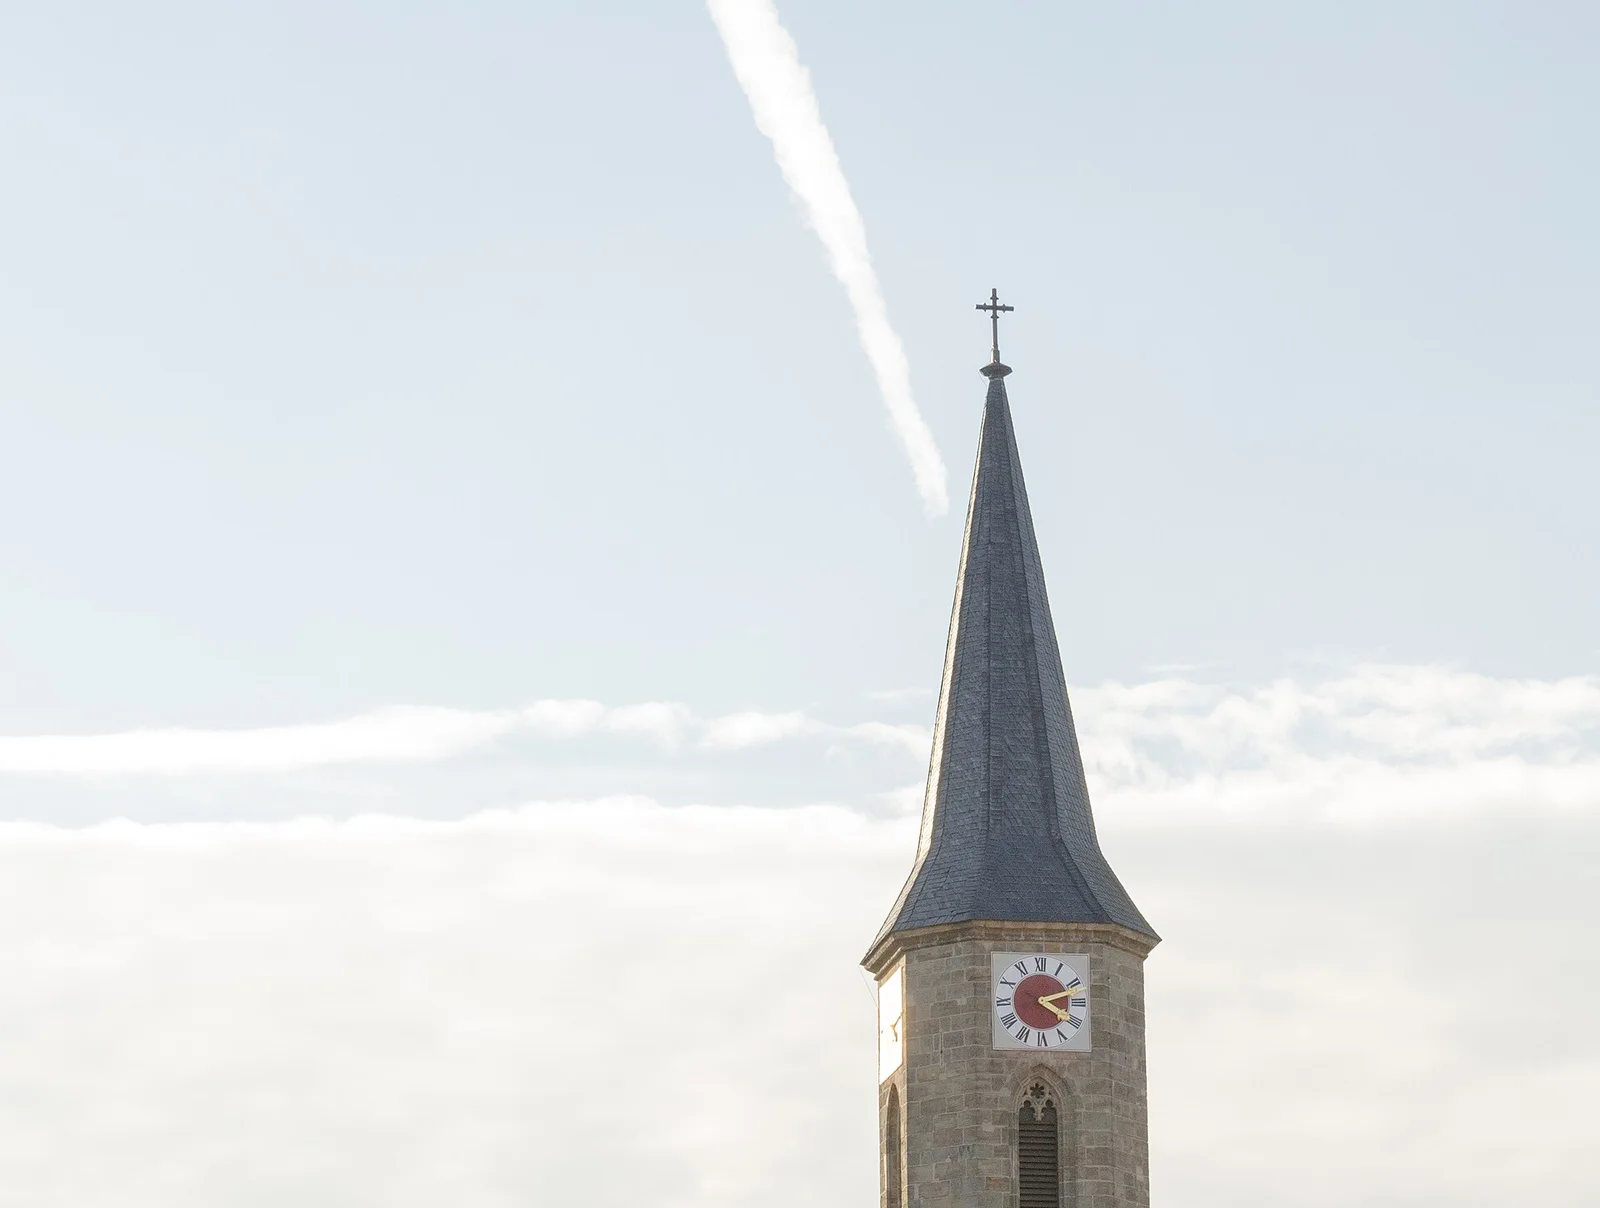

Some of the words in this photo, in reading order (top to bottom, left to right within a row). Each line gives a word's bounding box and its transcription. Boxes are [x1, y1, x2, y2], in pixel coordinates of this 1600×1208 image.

[1014, 961, 1029, 977] XI
[1035, 957, 1047, 972] XII
[1054, 963, 1064, 976] I
[1000, 977, 1016, 989] X
[1066, 977, 1081, 988] II
[996, 996, 1011, 1007] IX
[1071, 998, 1086, 1007] III
[1000, 1012, 1018, 1029] VIII
[1015, 1026, 1031, 1043] VII
[1037, 1032, 1048, 1046] VI
[1056, 1028, 1068, 1043] V
